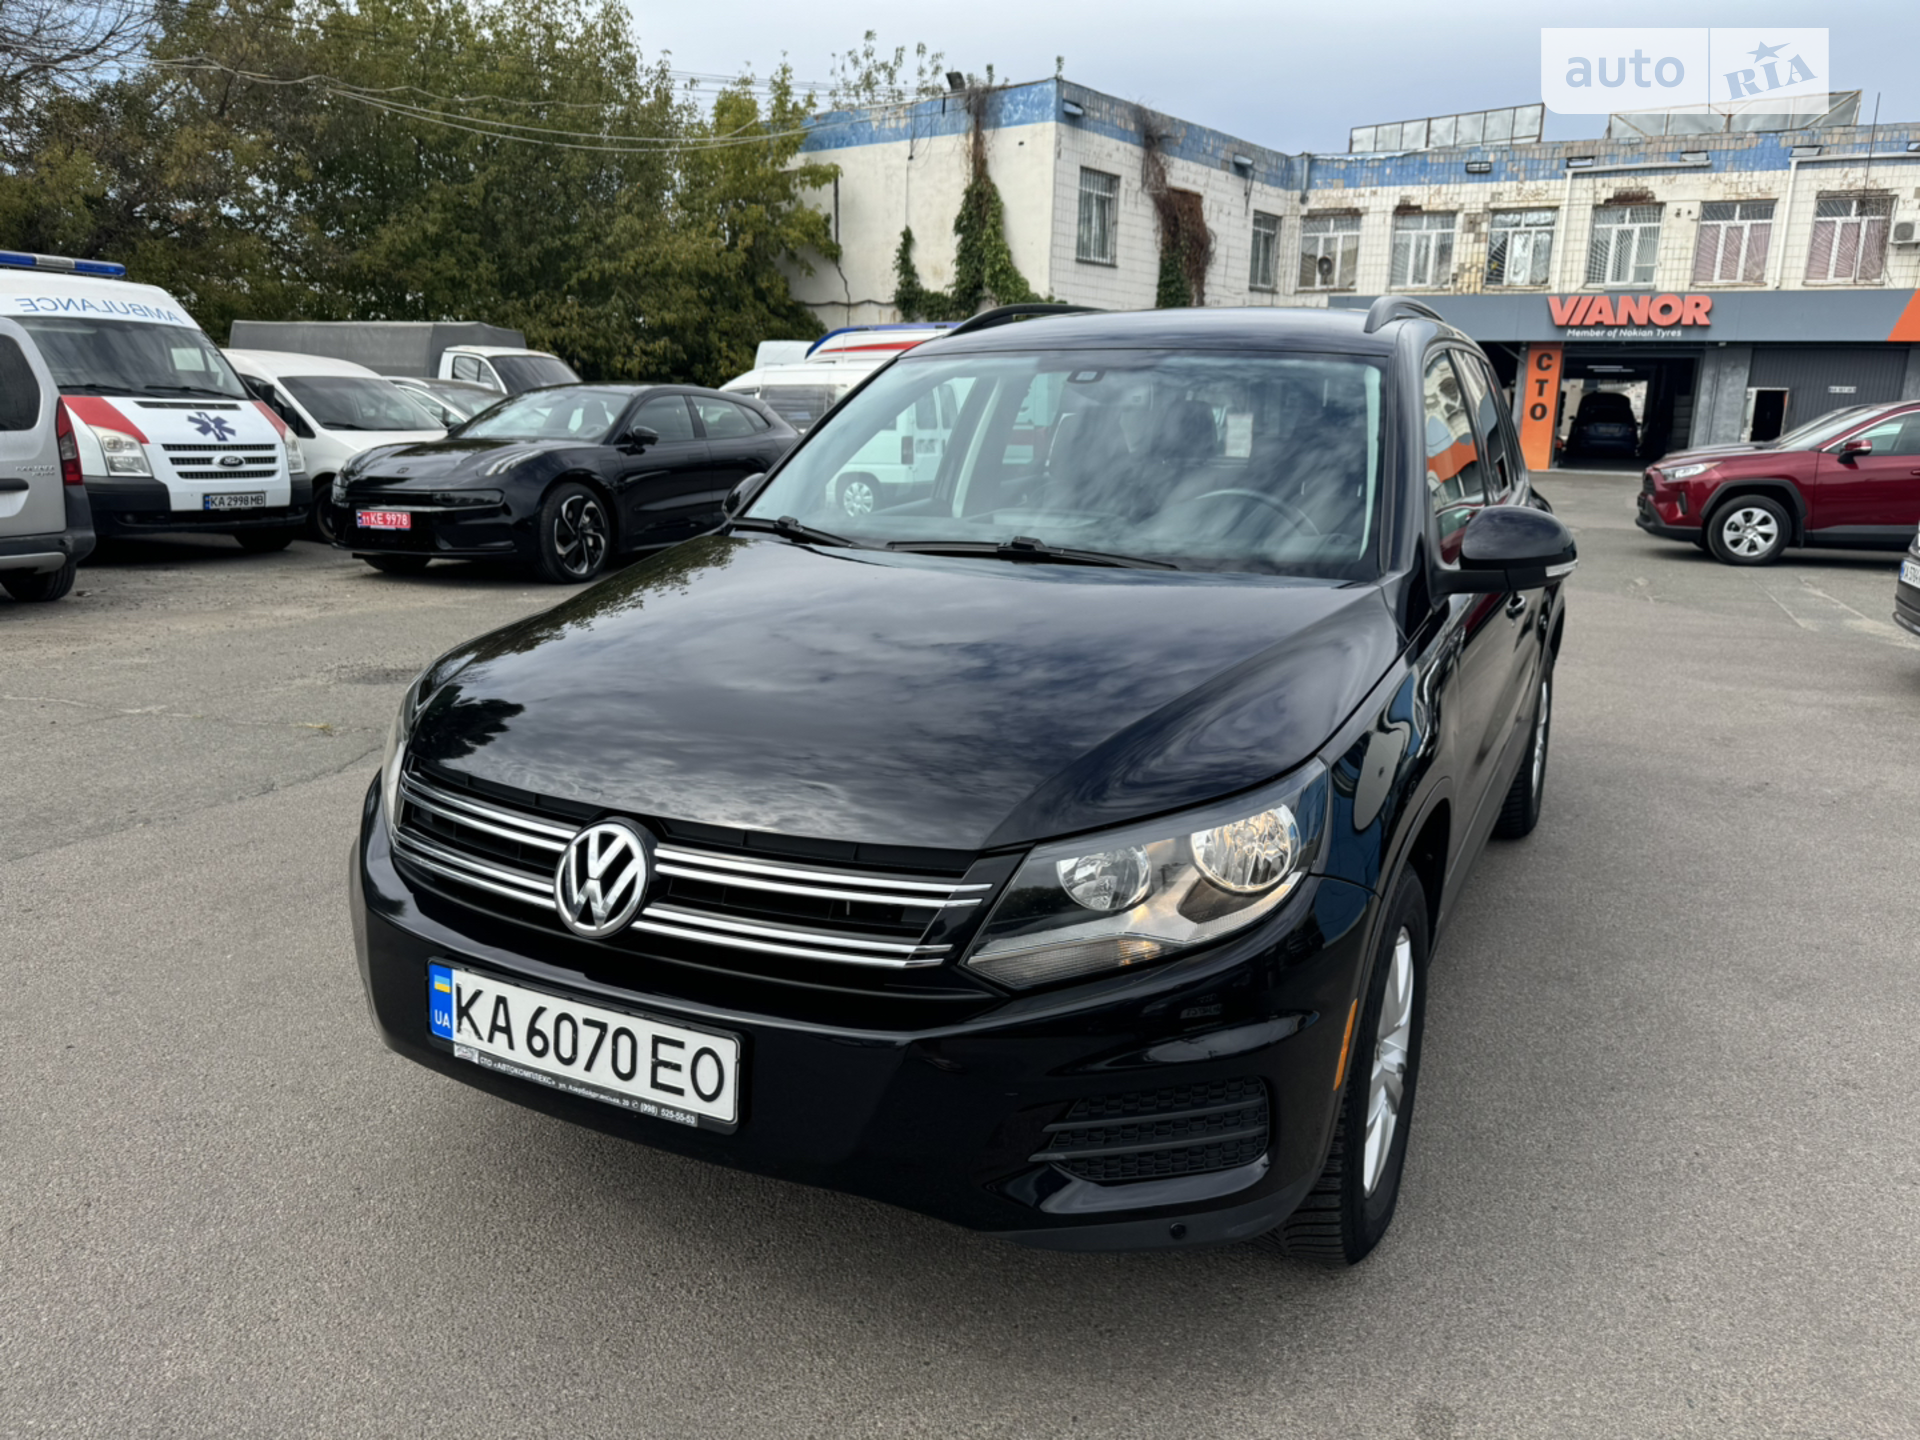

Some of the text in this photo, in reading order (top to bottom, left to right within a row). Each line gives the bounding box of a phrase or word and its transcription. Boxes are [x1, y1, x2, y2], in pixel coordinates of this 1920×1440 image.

[1548, 293, 1713, 327] VIANOR
[1566, 328, 1682, 339] Member of Nokian Tyres
[1529, 352, 1553, 422] СТО
[211, 494, 264, 507] KA 2998 MB
[434, 1009, 451, 1029] UA
[455, 982, 725, 1103] KA 6070 EO
